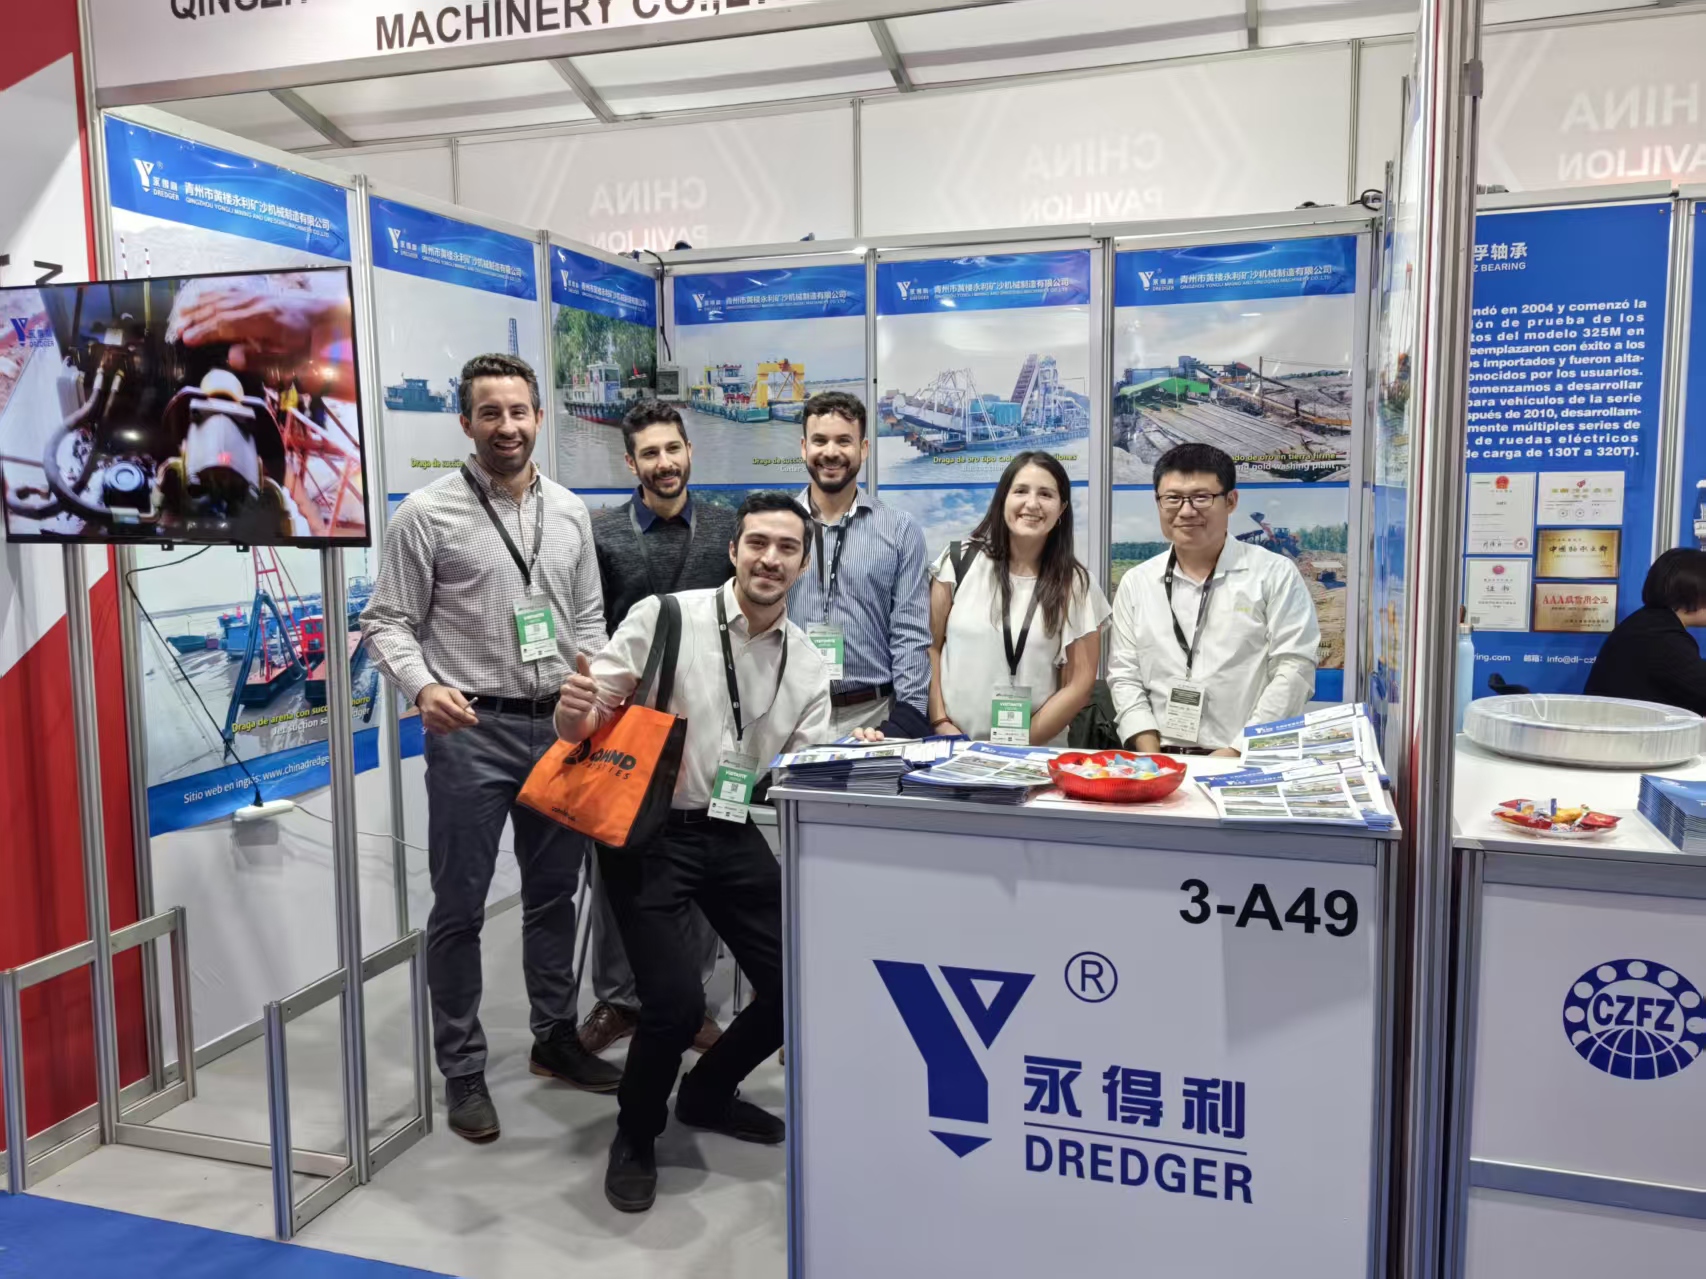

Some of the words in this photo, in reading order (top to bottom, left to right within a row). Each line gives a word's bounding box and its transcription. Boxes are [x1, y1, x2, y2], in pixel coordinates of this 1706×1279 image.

[375, 0, 612, 50] MACHINERY
[153, 189, 180, 201] DREDGER
[1474, 242, 1528, 261] 孚轴承
[1481, 262, 1526, 272] BEARING
[1501, 306, 1517, 314] en
[1521, 304, 1553, 313] 2004
[1557, 304, 1566, 315] y
[1569, 298, 1630, 312] comenzó
[1634, 299, 1647, 309] la
[1501, 318, 1520, 327] de
[1527, 315, 1585, 328] prueba
[1592, 314, 1612, 324] de
[1619, 313, 1645, 323] los
[1497, 331, 1519, 341] del
[1524, 329, 1577, 340] modelo
[1582, 327, 1621, 338] 325M
[1627, 327, 1645, 336] en
[1553, 342, 1577, 352] con
[1579, 339, 1611, 351] éxito
[1614, 342, 1623, 350] a
[1626, 339, 1645, 350] los
[1483, 356, 1555, 369] importados
[1558, 359, 1566, 368] y
[1569, 354, 1611, 365] fueron
[1614, 353, 1645, 364] alta-
[1530, 371, 1553, 381] por
[1556, 368, 1576, 378] los
[1580, 366, 1643, 378] usuarios.
[1554, 384, 1563, 392] a
[1567, 380, 1643, 391] desarrollar
[1500, 394, 1564, 406] vehículos
[1568, 395, 1585, 404] de
[1590, 393, 1602, 403] la
[1606, 393, 1642, 403] serie
[1505, 410, 1520, 419] de
[1523, 409, 1558, 420] 2010,
[1561, 407, 1642, 418] desarrollam-
[1467, 423, 1509, 432] mente
[1512, 421, 1575, 434] múltiples
[1578, 421, 1620, 431] series
[1623, 420, 1640, 430] de
[1475, 436, 1493, 445] de
[1499, 434, 1552, 445] ruedas
[1558, 432, 1639, 444] eléctricos
[933, 456, 954, 465] Draga
[956, 455, 965, 463] de
[981, 455, 996, 464] tipo
[1483, 449, 1522, 460] carga
[1526, 448, 1542, 458] de
[1548, 448, 1580, 458] 130T
[1584, 449, 1592, 457] a
[1596, 446, 1640, 458] 320T).
[411, 457, 431, 470] Draga
[752, 457, 771, 466] Draga
[1252, 462, 1271, 472] gold
[1272, 462, 1310, 472] washing
[231, 721, 256, 734] Draga
[257, 718, 269, 726] de
[270, 713, 294, 723] arena
[295, 708, 310, 719] con
[287, 719, 318, 733] suction
[183, 790, 204, 804] Sitio
[205, 785, 223, 797] web
[223, 781, 234, 791] en
[1178, 877, 1359, 939] 3-A49
[1592, 992, 1675, 1033] CZFZ
[1023, 1054, 1246, 1140] 永得利
[1024, 1133, 1254, 1204] DREDGER
